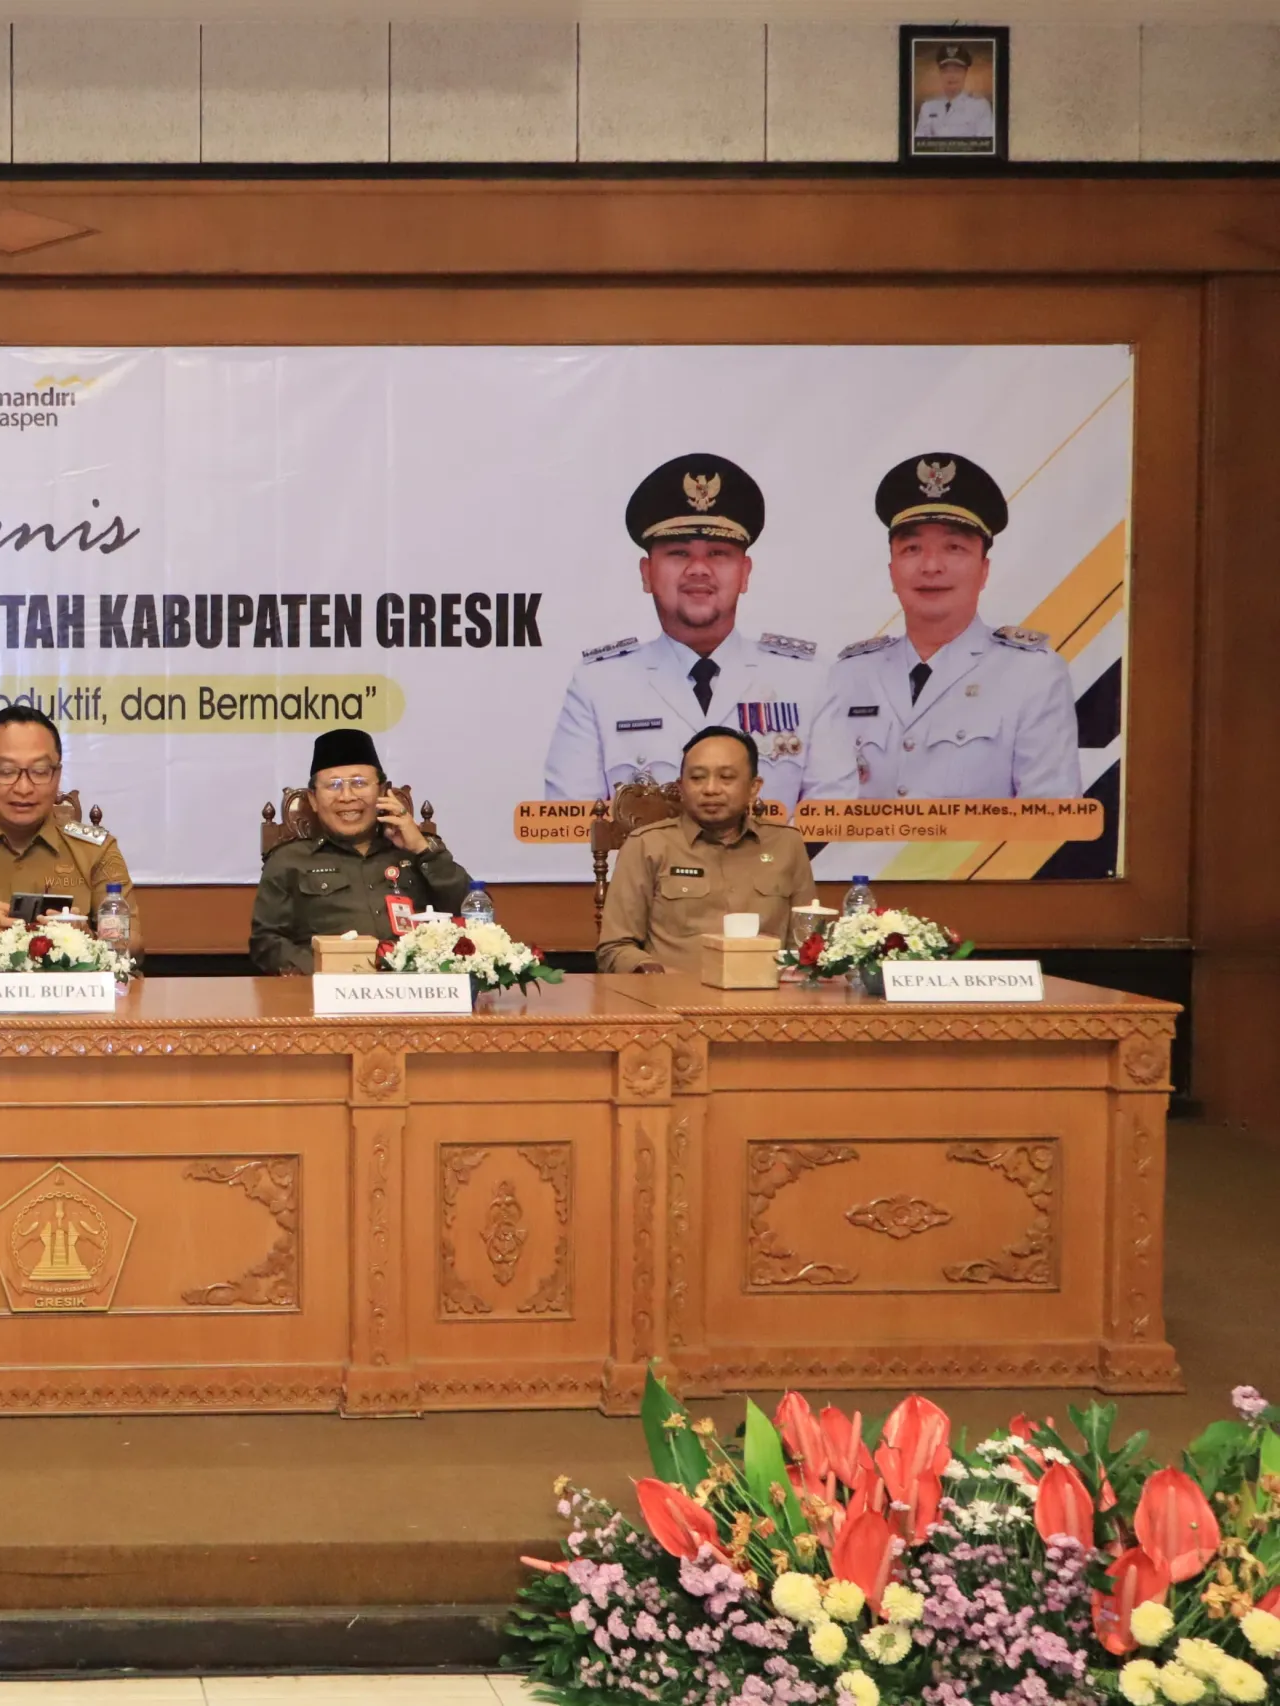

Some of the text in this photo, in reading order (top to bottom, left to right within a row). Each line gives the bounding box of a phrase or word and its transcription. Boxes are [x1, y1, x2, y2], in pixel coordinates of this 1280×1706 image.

[99, 593, 362, 649] KABUPATEN
[375, 592, 543, 649] GRESIK
[120, 686, 186, 721] dan
[520, 805, 534, 817] H.
[539, 805, 585, 817] FANDI
[799, 803, 820, 817] dr.
[824, 803, 840, 817] H.
[843, 803, 925, 817] ASLUCHUL
[927, 803, 961, 816] ALIF
[1058, 803, 1098, 816] M.HP
[520, 825, 569, 839] Bupati
[799, 824, 948, 839] Wakil Bupati Gresik
[891, 975, 1034, 988] KEPALA BKPSDM
[41, 985, 106, 998] BUPATI
[335, 986, 460, 1000] NARASUMBER
[34, 1297, 87, 1308] GRESIK
